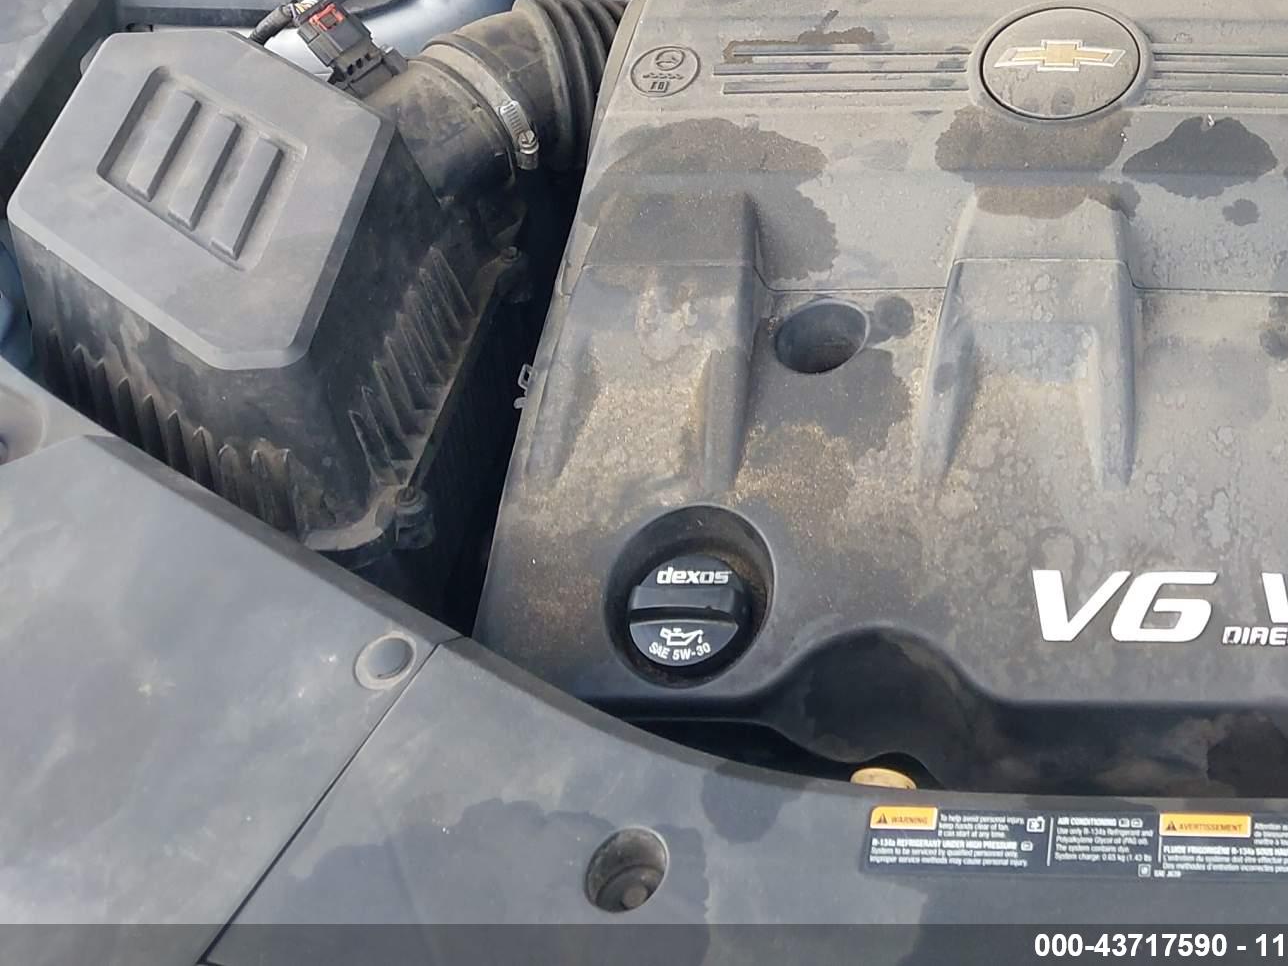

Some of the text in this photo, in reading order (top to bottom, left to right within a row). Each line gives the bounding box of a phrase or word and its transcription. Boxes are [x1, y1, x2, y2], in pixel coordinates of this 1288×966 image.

[657, 566, 729, 584] dexos
[1031, 569, 1217, 643] V6
[648, 641, 711, 661] SAE 5W-30
